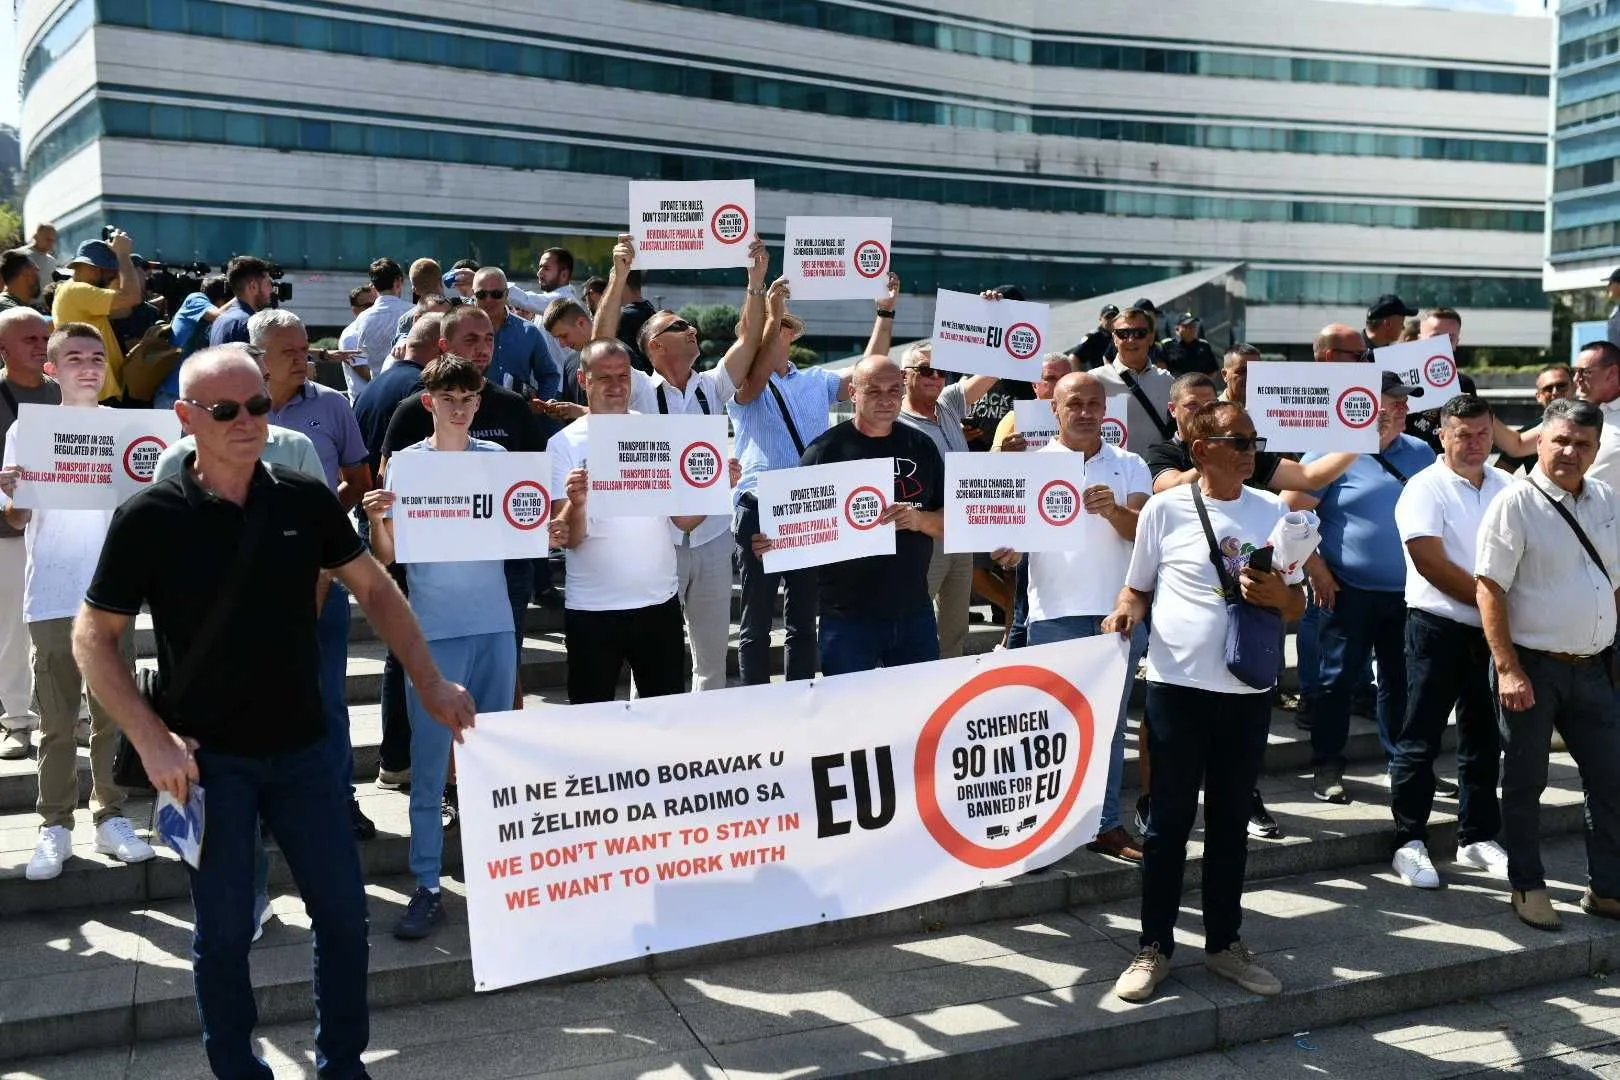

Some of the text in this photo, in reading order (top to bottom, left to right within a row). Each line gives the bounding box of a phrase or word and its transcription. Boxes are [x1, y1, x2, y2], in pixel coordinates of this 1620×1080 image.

[679, 200, 687, 210] THE
[643, 212, 657, 222] DON'T
[658, 212, 669, 222] STOP
[670, 212, 679, 222] THE
[986, 326, 1002, 348] EU
[1410, 368, 1420, 385] EU
[1258, 387, 1264, 395] WE
[980, 392, 1010, 406] ACK
[1280, 396, 1291, 404] THEY
[1292, 396, 1306, 404] COUNT
[1307, 396, 1316, 404] OUR
[969, 404, 1009, 418] JONE
[54, 433, 114, 447] TRANSPORT IN 2026,
[618, 441, 671, 451] TRANSPORT IN 2026,
[54, 445, 114, 456] REGULATED BY 1985.
[132, 453, 142, 461] 90
[619, 453, 671, 462] REGULATED BY 1985.
[55, 461, 112, 473] TRANSPORT U 2026.
[21, 471, 112, 484] REGULISAN PROPISOM IZ 1985.
[620, 469, 651, 478] TRANSPORT
[652, 469, 655, 478] U
[592, 480, 622, 490] REGULISAN
[624, 480, 650, 490] PROPISOM
[651, 480, 657, 490] IZ
[959, 479, 1026, 489] THE WORLD CHANGED, BUT
[411, 496, 426, 504] DON'T
[427, 496, 443, 504] WANT
[444, 496, 450, 504] TO
[451, 496, 464, 504] STAY
[464, 496, 470, 504] IN
[791, 488, 810, 501] UPDATE
[810, 487, 819, 498] THE
[956, 490, 1026, 499] SCHENGEN RULES HAVE NOT
[473, 494, 493, 519] EU
[513, 499, 521, 507] 90
[530, 498, 541, 507] 180
[852, 503, 860, 511] 90
[867, 501, 878, 509] 180
[408, 510, 416, 518] WE
[417, 510, 432, 518] WANT
[440, 510, 456, 518] WORK
[456, 509, 470, 517] WITH
[773, 504, 788, 517] DON'T
[789, 502, 802, 515] STOP
[803, 501, 812, 512] THE
[980, 505, 986, 514] SE
[1017, 505, 1025, 514] ALI
[990, 515, 1012, 524] PRAVILA
[1012, 515, 1026, 524] NISU
[967, 710, 1049, 740] SCHENGEN
[953, 733, 1066, 780] 90 IN 180
[492, 750, 784, 808] MI NE ŽELIMO BORAVAK U
[811, 745, 896, 838] EU
[957, 777, 1032, 800] DRIVING FOR
[1035, 769, 1061, 804] EU
[498, 782, 785, 842] MI ŽELIMO DA RADIMO SA
[967, 794, 1032, 818] BANNED BY
[487, 856, 522, 880] WE
[605, 831, 672, 855] WANT
[679, 827, 709, 844] TO
[716, 818, 770, 840] STAY
[778, 813, 800, 832] IN
[505, 845, 786, 910] WE WANT TO WORK WITH
